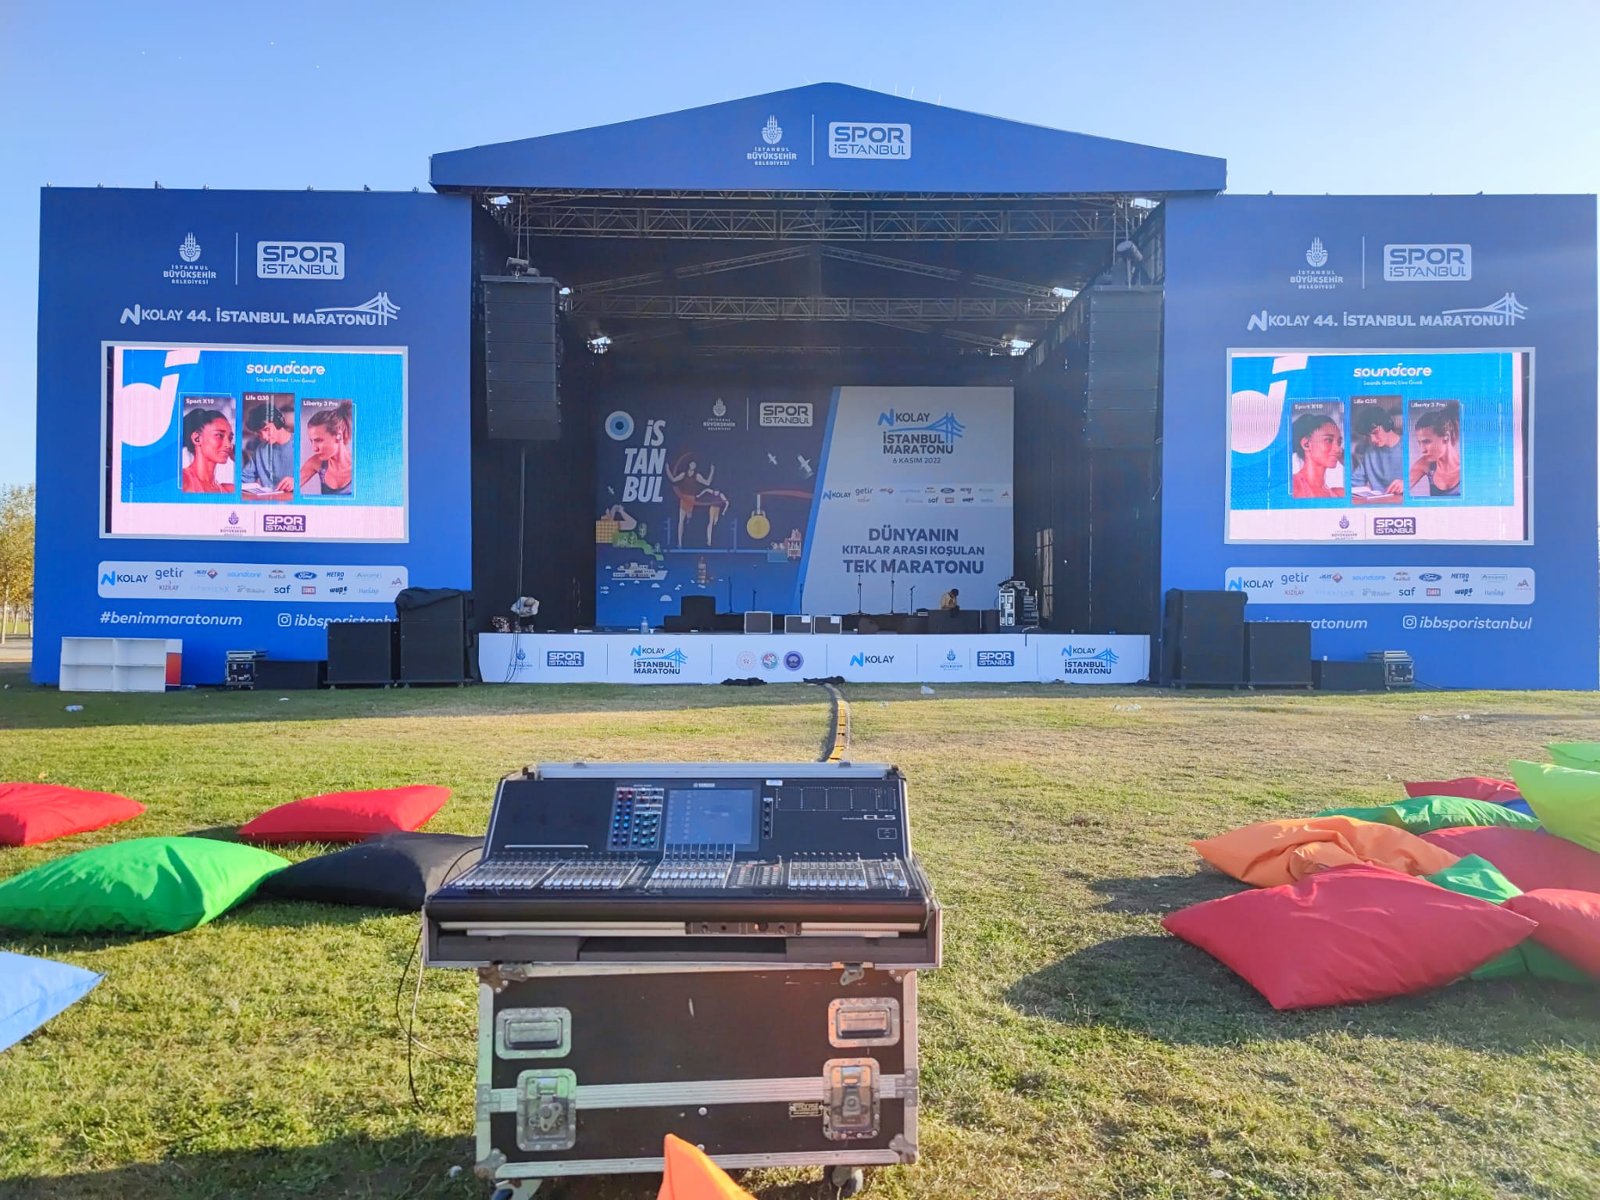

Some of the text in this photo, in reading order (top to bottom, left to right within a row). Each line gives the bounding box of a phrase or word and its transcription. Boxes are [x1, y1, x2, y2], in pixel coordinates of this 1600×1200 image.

[834, 126, 904, 143] SPOR
[263, 246, 338, 263] SPOR
[1390, 248, 1465, 265] SPOR
[187, 310, 212, 322] 44.
[216, 307, 290, 324] İSTANBUL
[292, 312, 376, 326] MARATONU
[1314, 316, 1338, 327] 44.
[1344, 312, 1416, 327] İSTANBUL
[1420, 315, 1504, 326] MARATONU
[246, 360, 326, 375] soundcore
[1353, 363, 1432, 378] soundcore
[764, 406, 808, 416] SPOR
[883, 432, 944, 444] İSTANBUL
[883, 444, 954, 454] MARATONU
[624, 448, 666, 474] TAN
[622, 476, 663, 502] BUL
[266, 516, 302, 525] SPOR
[1376, 519, 1413, 528] SPOR
[868, 524, 959, 542] DÜNYANIN
[842, 545, 985, 556] KITALAR ARASI KOŞULAN
[156, 568, 184, 580] getir
[843, 560, 984, 574] TEK MARATONU
[1281, 572, 1309, 585] getir
[274, 584, 291, 594] saf
[1398, 587, 1416, 596] saf
[100, 611, 242, 625] #benimmaratonum
[1420, 616, 1533, 631] ibbsporistanbul
